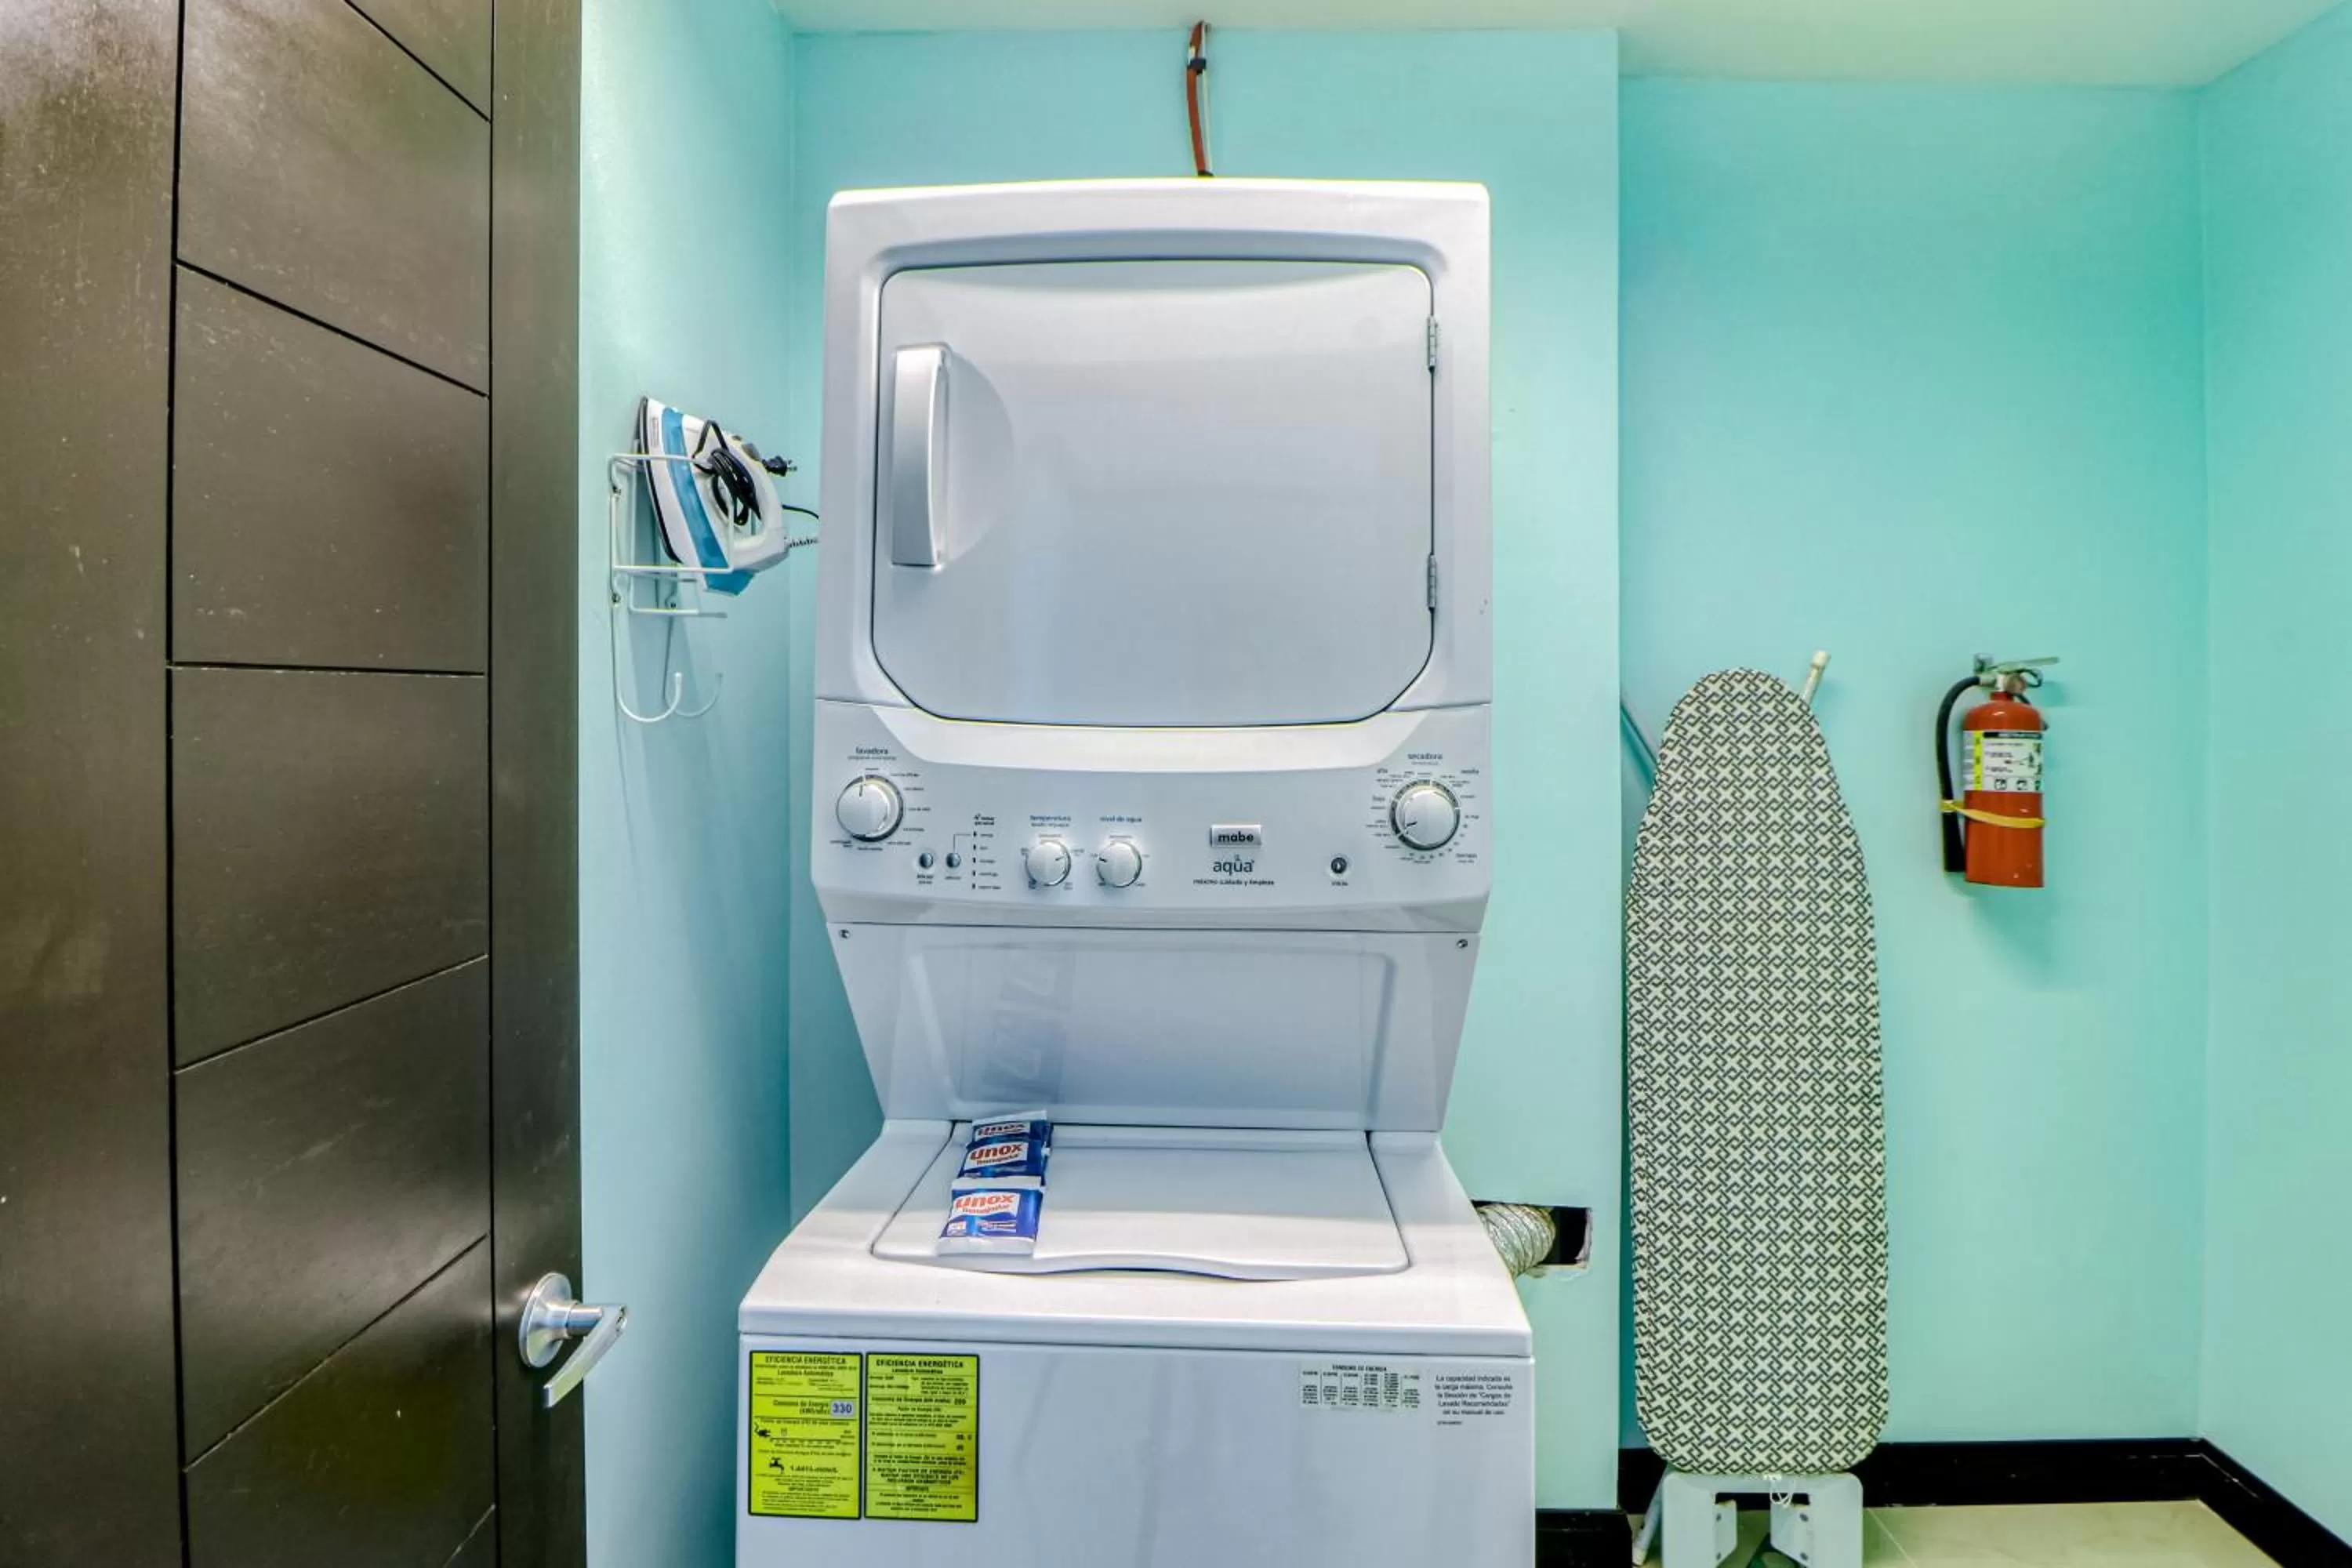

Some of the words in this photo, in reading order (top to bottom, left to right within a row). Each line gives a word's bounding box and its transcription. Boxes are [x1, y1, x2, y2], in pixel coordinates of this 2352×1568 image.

[1218, 831, 1254, 843] mabe
[970, 1144, 1023, 1160] unox
[956, 1194, 1014, 1208] unox
[832, 1402, 852, 1414] 330
